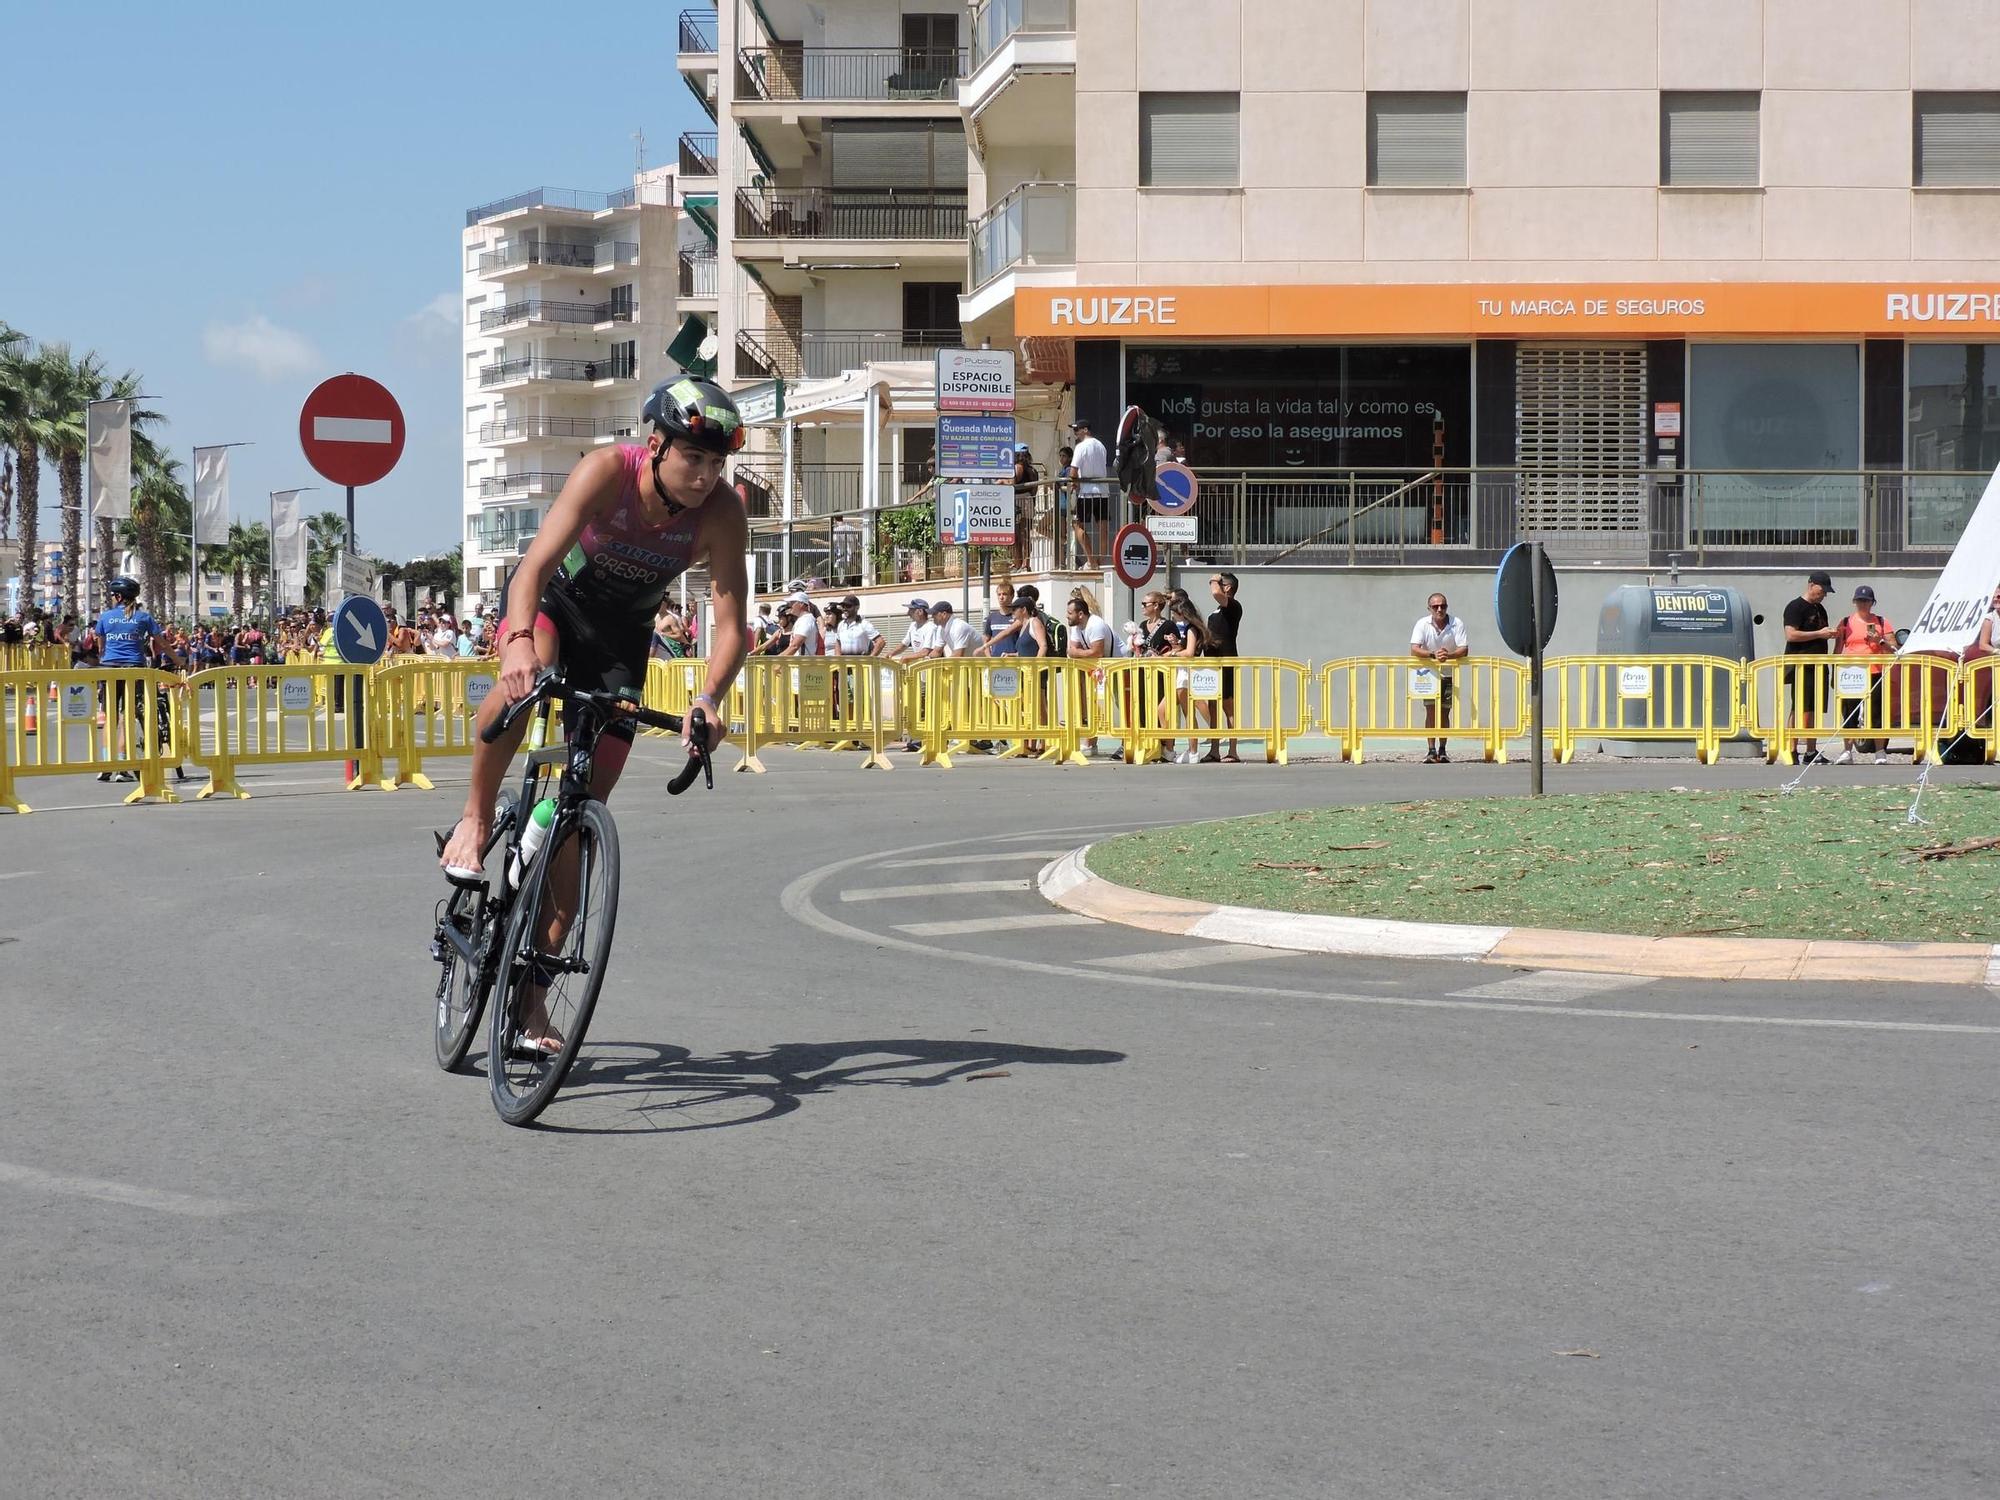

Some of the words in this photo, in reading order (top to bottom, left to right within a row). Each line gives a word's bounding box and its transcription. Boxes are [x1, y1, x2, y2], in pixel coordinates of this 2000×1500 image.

[1051, 297, 1176, 324] RUIZRE
[1478, 300, 1502, 316] TU
[1510, 300, 1576, 316] MARCA
[1583, 300, 1608, 316] DE
[1615, 300, 1705, 316] SEGUROS
[952, 371, 1002, 382] ESPACIO
[942, 383, 1012, 394] DISPONIBLE
[1161, 399, 1196, 414] Nos
[1201, 399, 1250, 417] gusta
[1256, 398, 1270, 414] la
[1276, 398, 1312, 414] vida
[1317, 399, 1338, 414] tal
[1343, 402, 1354, 418] y
[1359, 402, 1409, 414] como
[942, 424, 980, 433] Quesada
[982, 424, 1013, 433] Market
[1193, 423, 1225, 438] Por
[1229, 426, 1263, 438] eso
[1268, 423, 1284, 438] la
[1289, 426, 1403, 441] aseguramos
[969, 506, 1002, 515] PACIO
[593, 552, 659, 584] CRESPO
[1655, 595, 1706, 611] DENTRO
